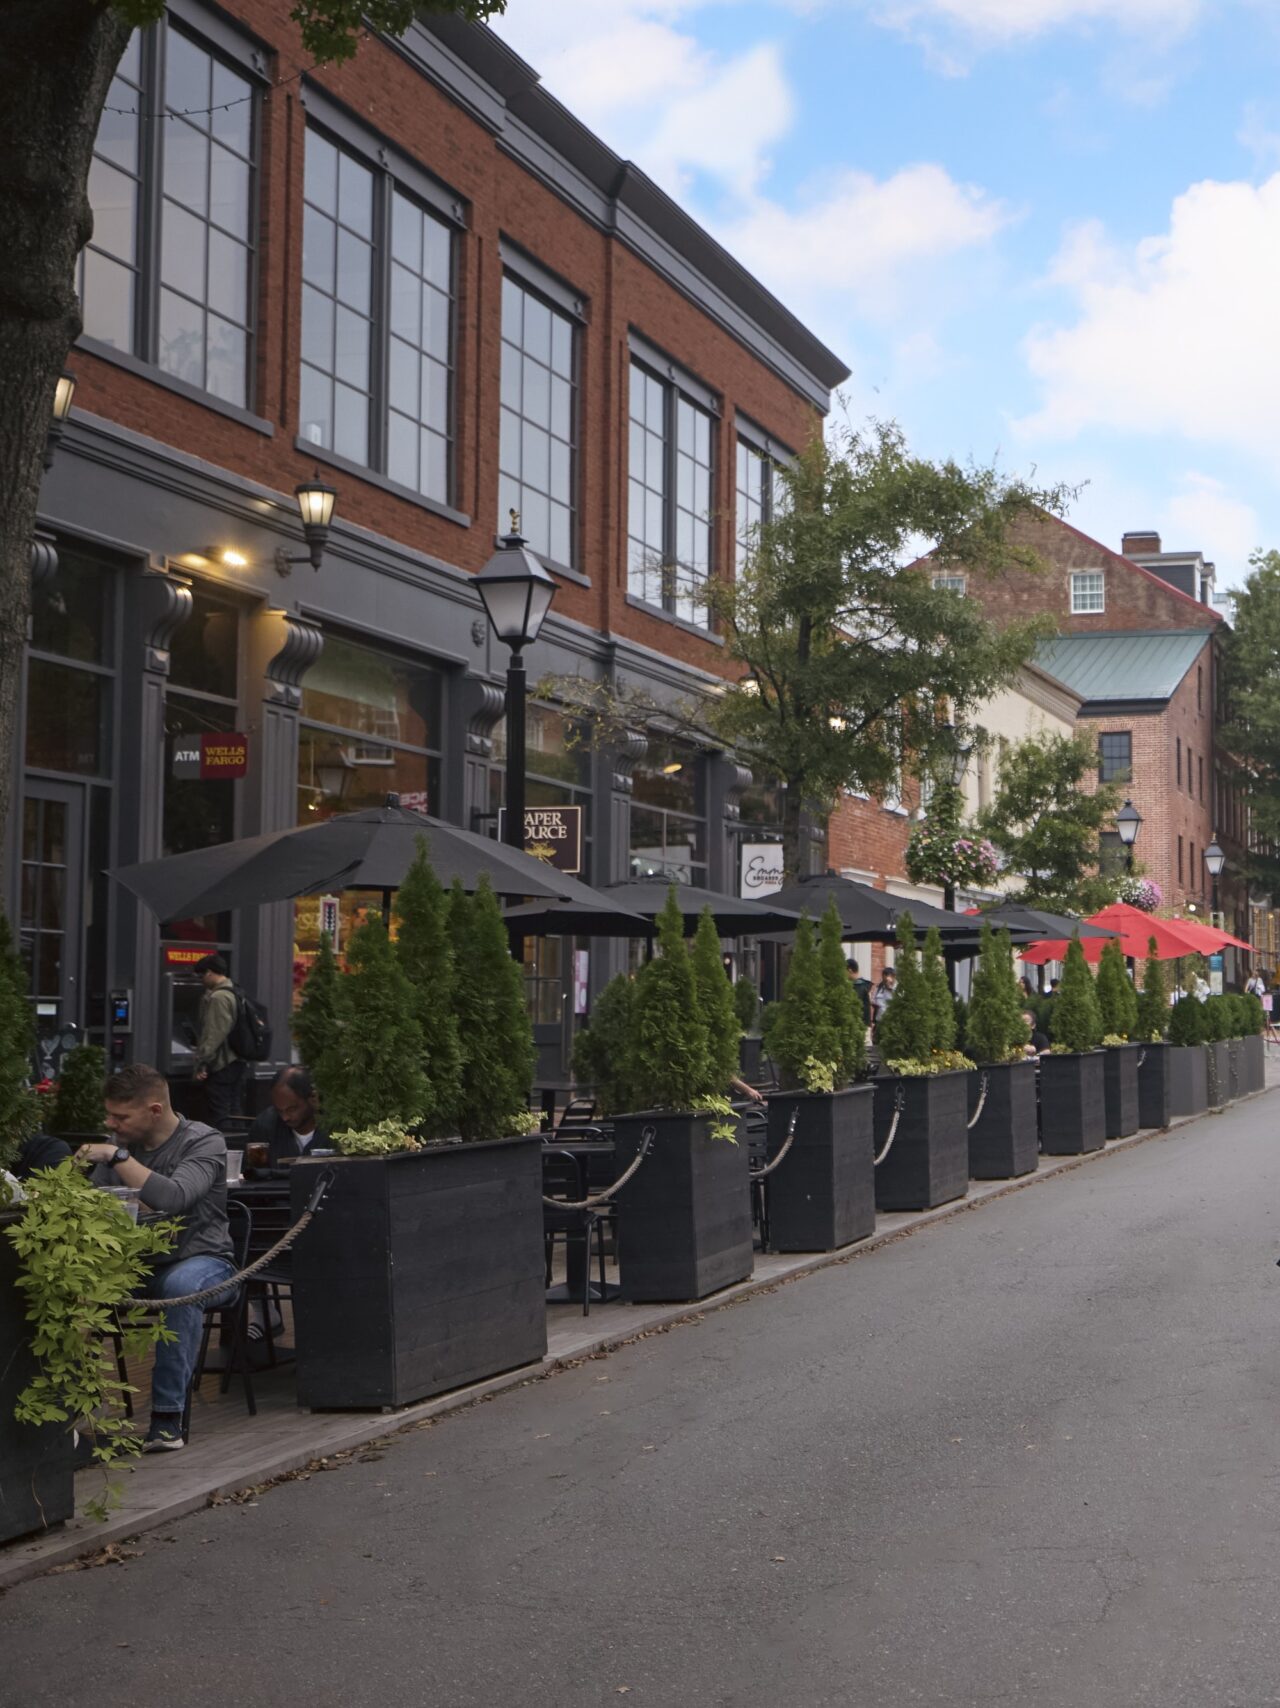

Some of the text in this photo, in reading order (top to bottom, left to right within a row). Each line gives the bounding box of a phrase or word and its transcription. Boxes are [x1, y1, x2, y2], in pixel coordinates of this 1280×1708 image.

[174, 750, 200, 762] ATM
[204, 746, 245, 756] WELLS
[205, 756, 245, 766] FARGO
[524, 812, 562, 826] APER
[524, 826, 568, 839] OURCE
